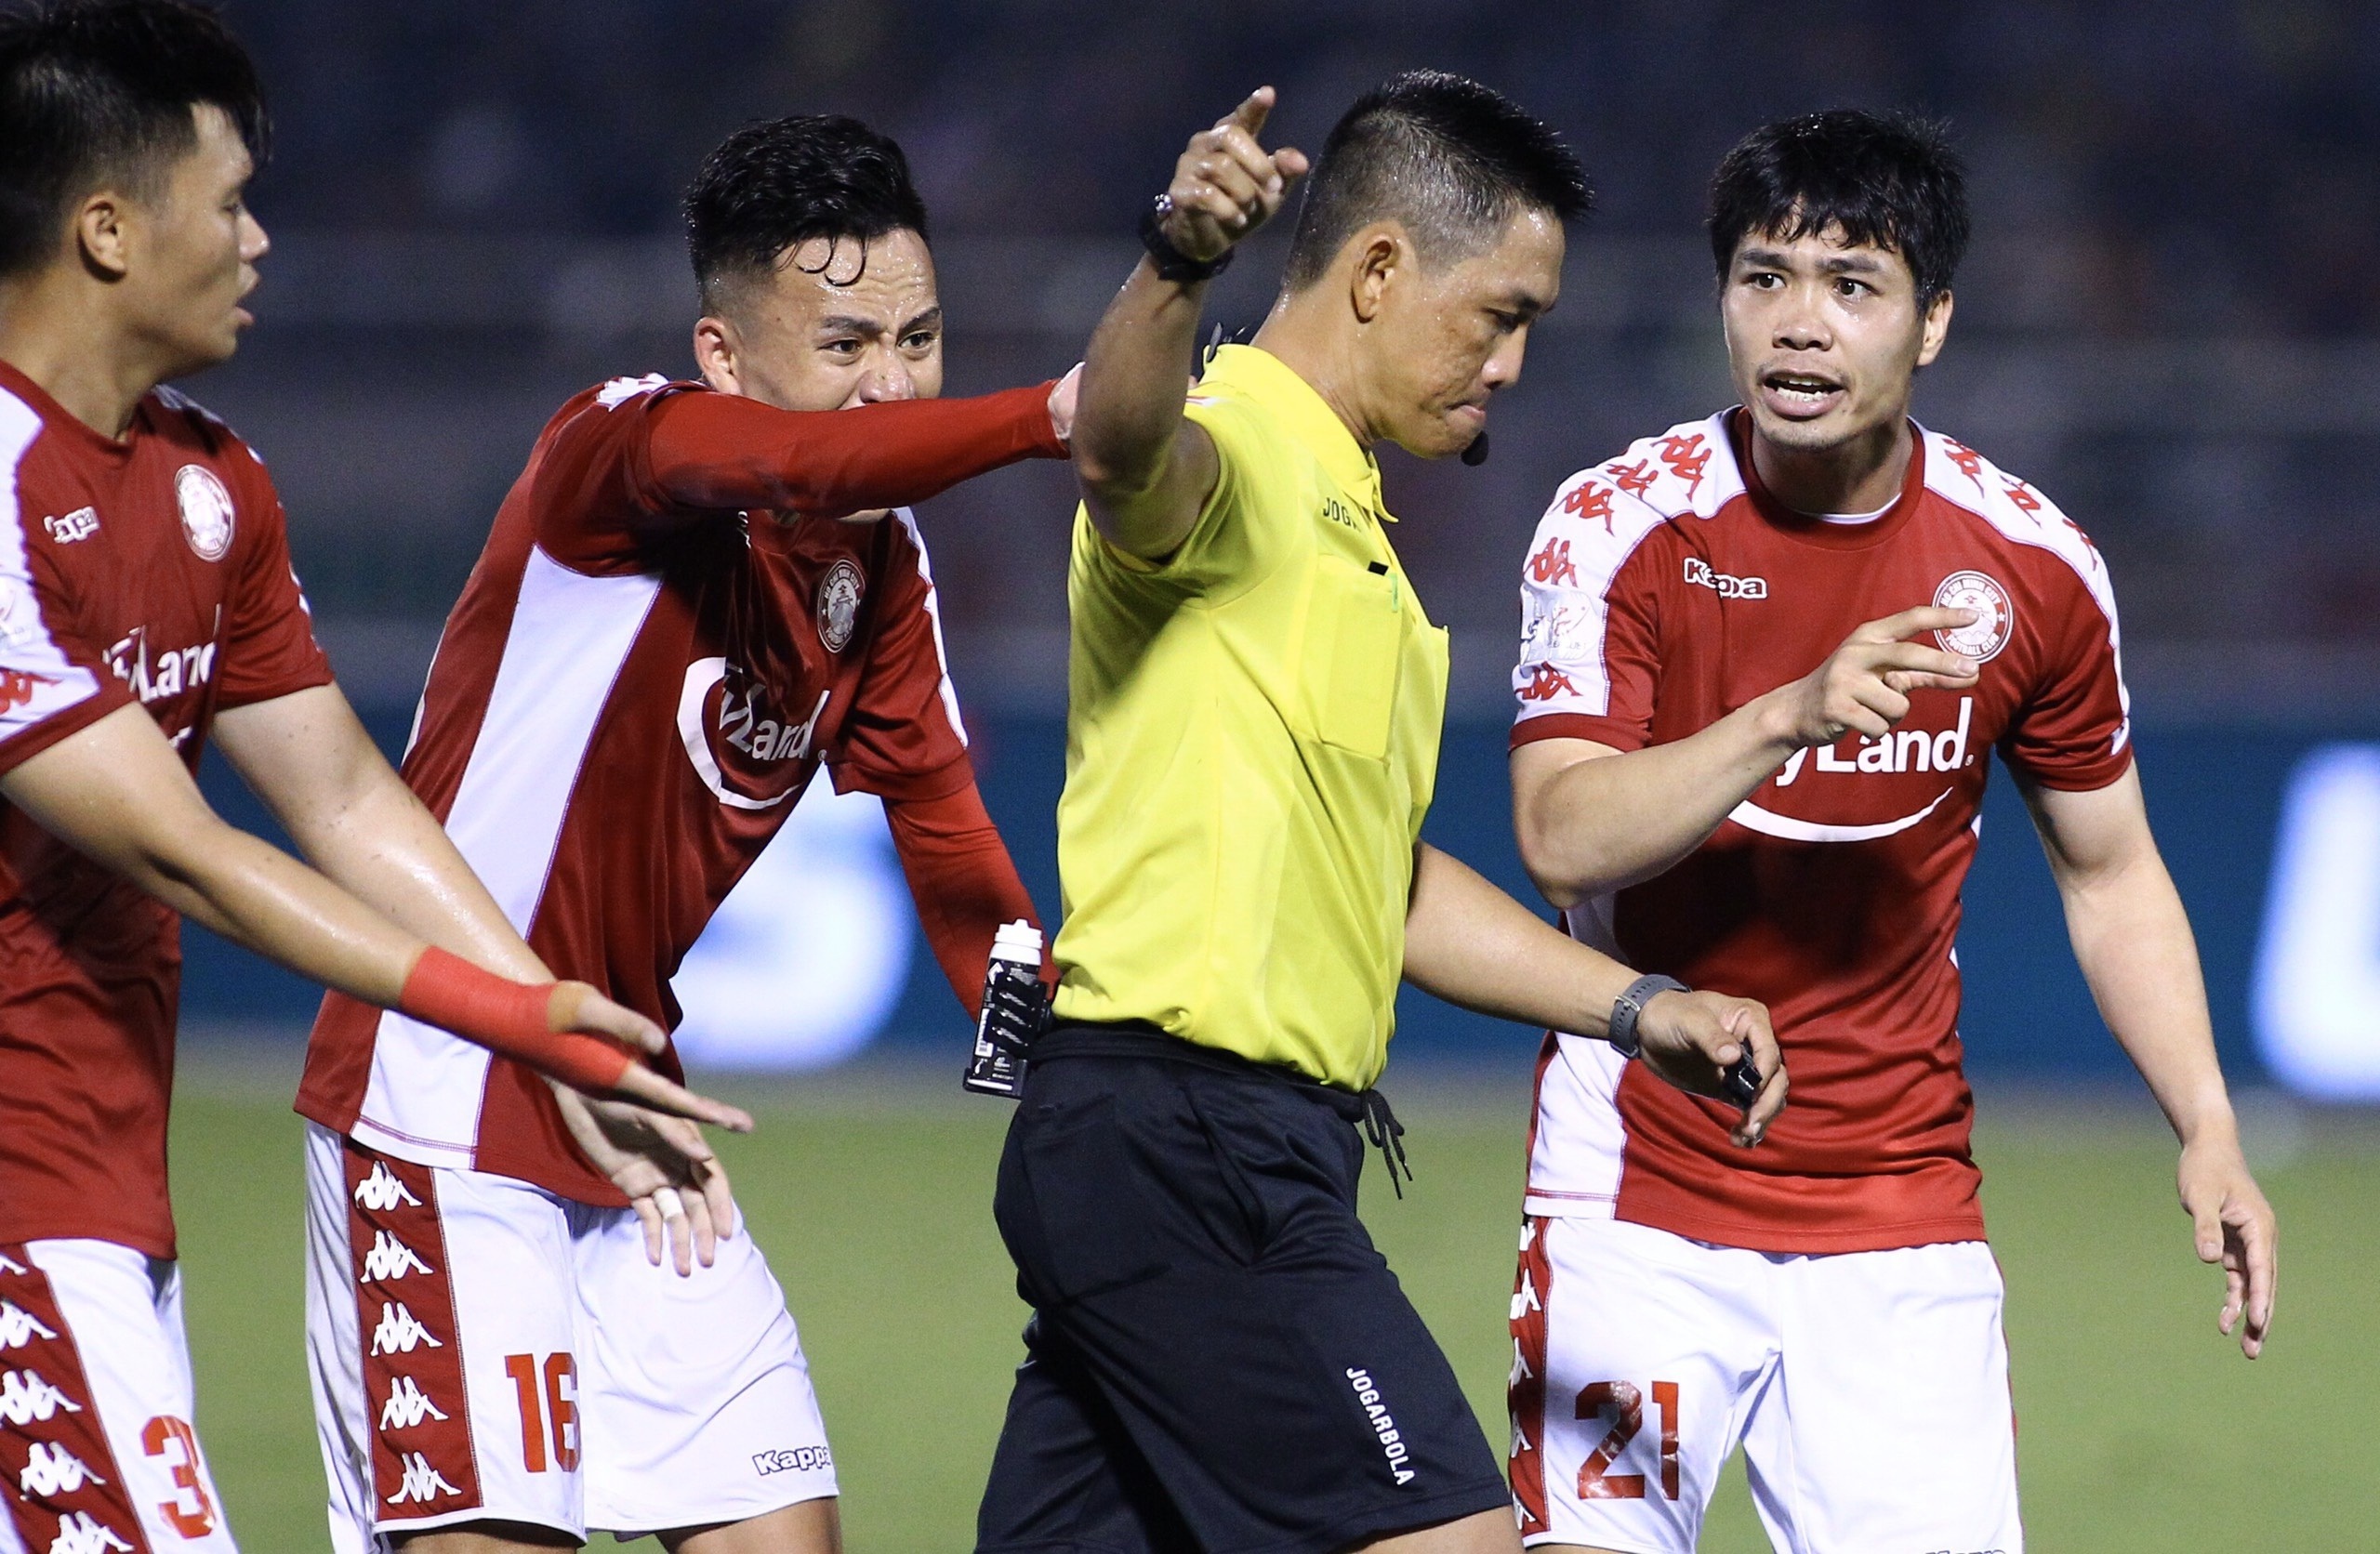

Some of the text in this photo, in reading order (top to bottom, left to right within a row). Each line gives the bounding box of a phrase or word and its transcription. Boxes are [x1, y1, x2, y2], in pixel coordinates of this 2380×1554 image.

[1939, 578, 2003, 608] HO CHI MINH CITY
[1945, 633, 2001, 656] FOOTBALL CLUB
[504, 1352, 582, 1473] 16
[1345, 1367, 1416, 1486] JOGARBOLA
[1575, 1380, 1680, 1501] 21
[140, 1415, 218, 1540] 3
